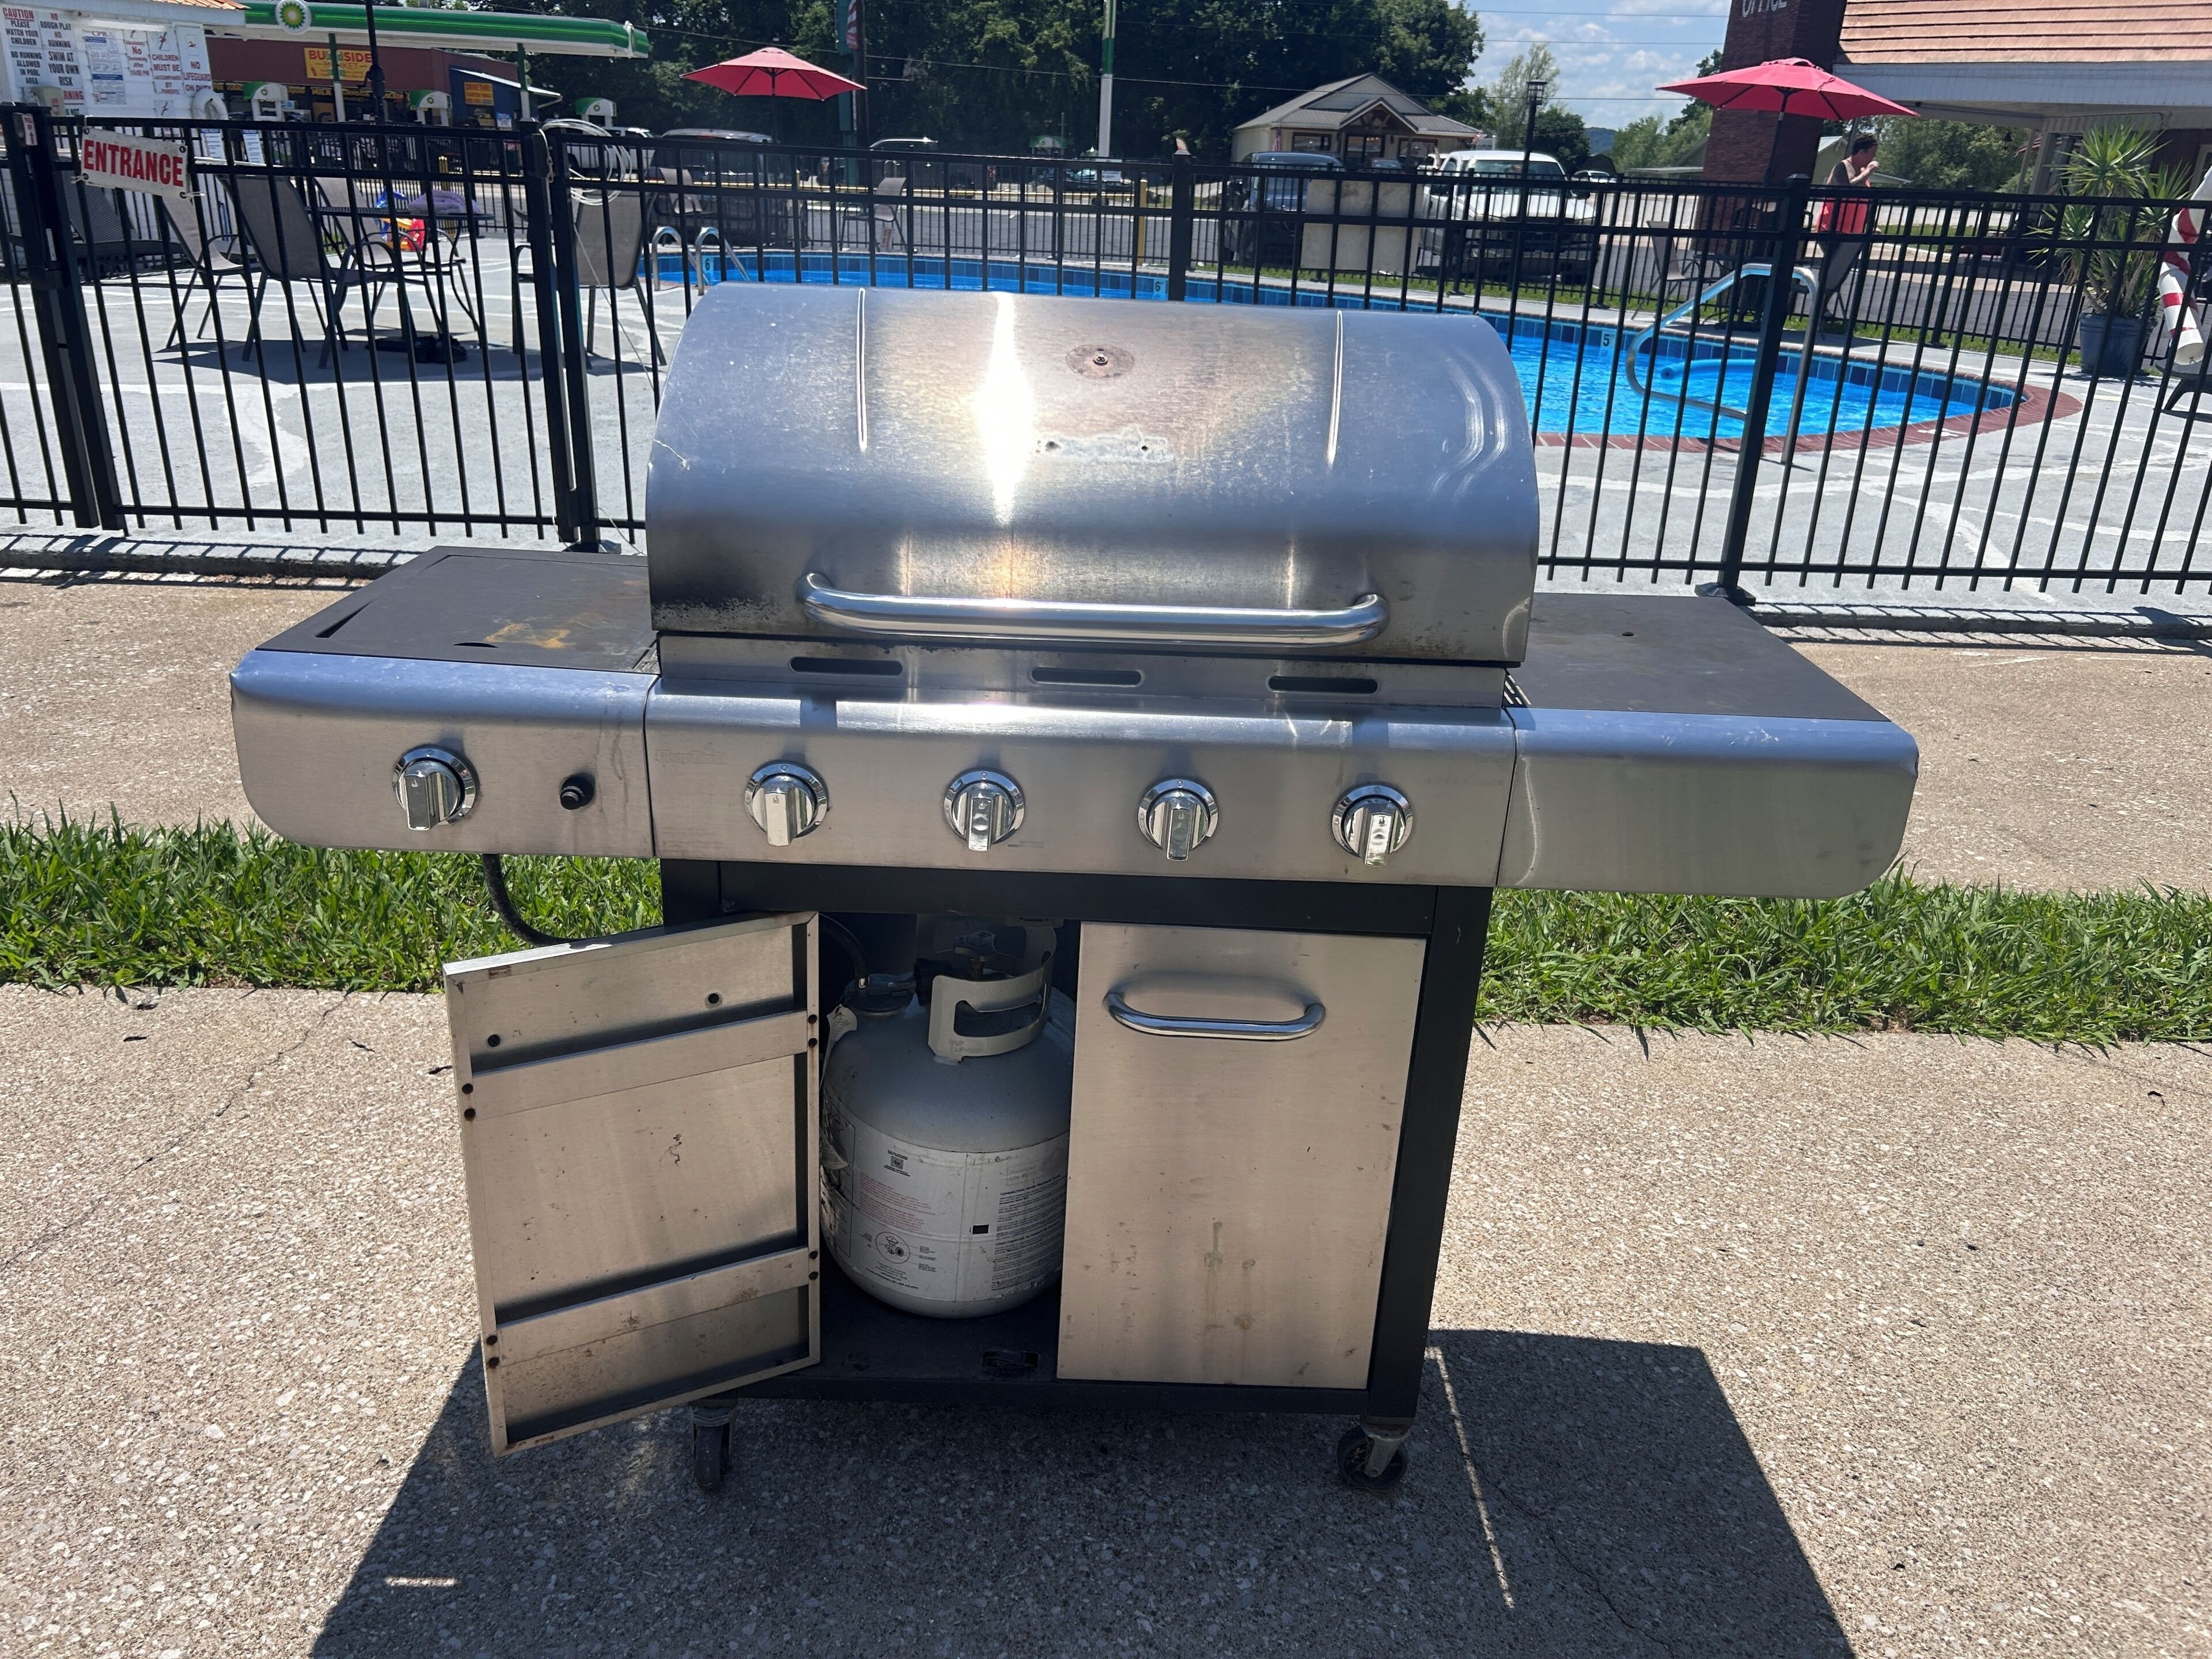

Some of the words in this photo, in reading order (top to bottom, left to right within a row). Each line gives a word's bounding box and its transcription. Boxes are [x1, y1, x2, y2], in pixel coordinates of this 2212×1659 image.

[3, 7, 34, 20] CAUTION
[50, 13, 58, 21] NO
[11, 20, 30, 28] PLEASE
[40, 21, 58, 29] ROUGH
[5, 28, 24, 36] WATCH
[11, 37, 36, 46] CHILDREN
[48, 40, 71, 48] RUNNING
[131, 46, 142, 55] No
[48, 51, 65, 62] SWIM
[67, 52, 74, 62] AT
[309, 50, 372, 62] BUSIDE
[48, 63, 65, 74] YOUR
[65, 65, 79, 74] OWN
[191, 61, 201, 69] NO
[324, 61, 358, 69] MKET
[59, 76, 73, 86] RISK
[184, 72, 211, 81] LIFEGUARD
[64, 90, 84, 100] RNING
[84, 139, 184, 187] ENTRANCE
